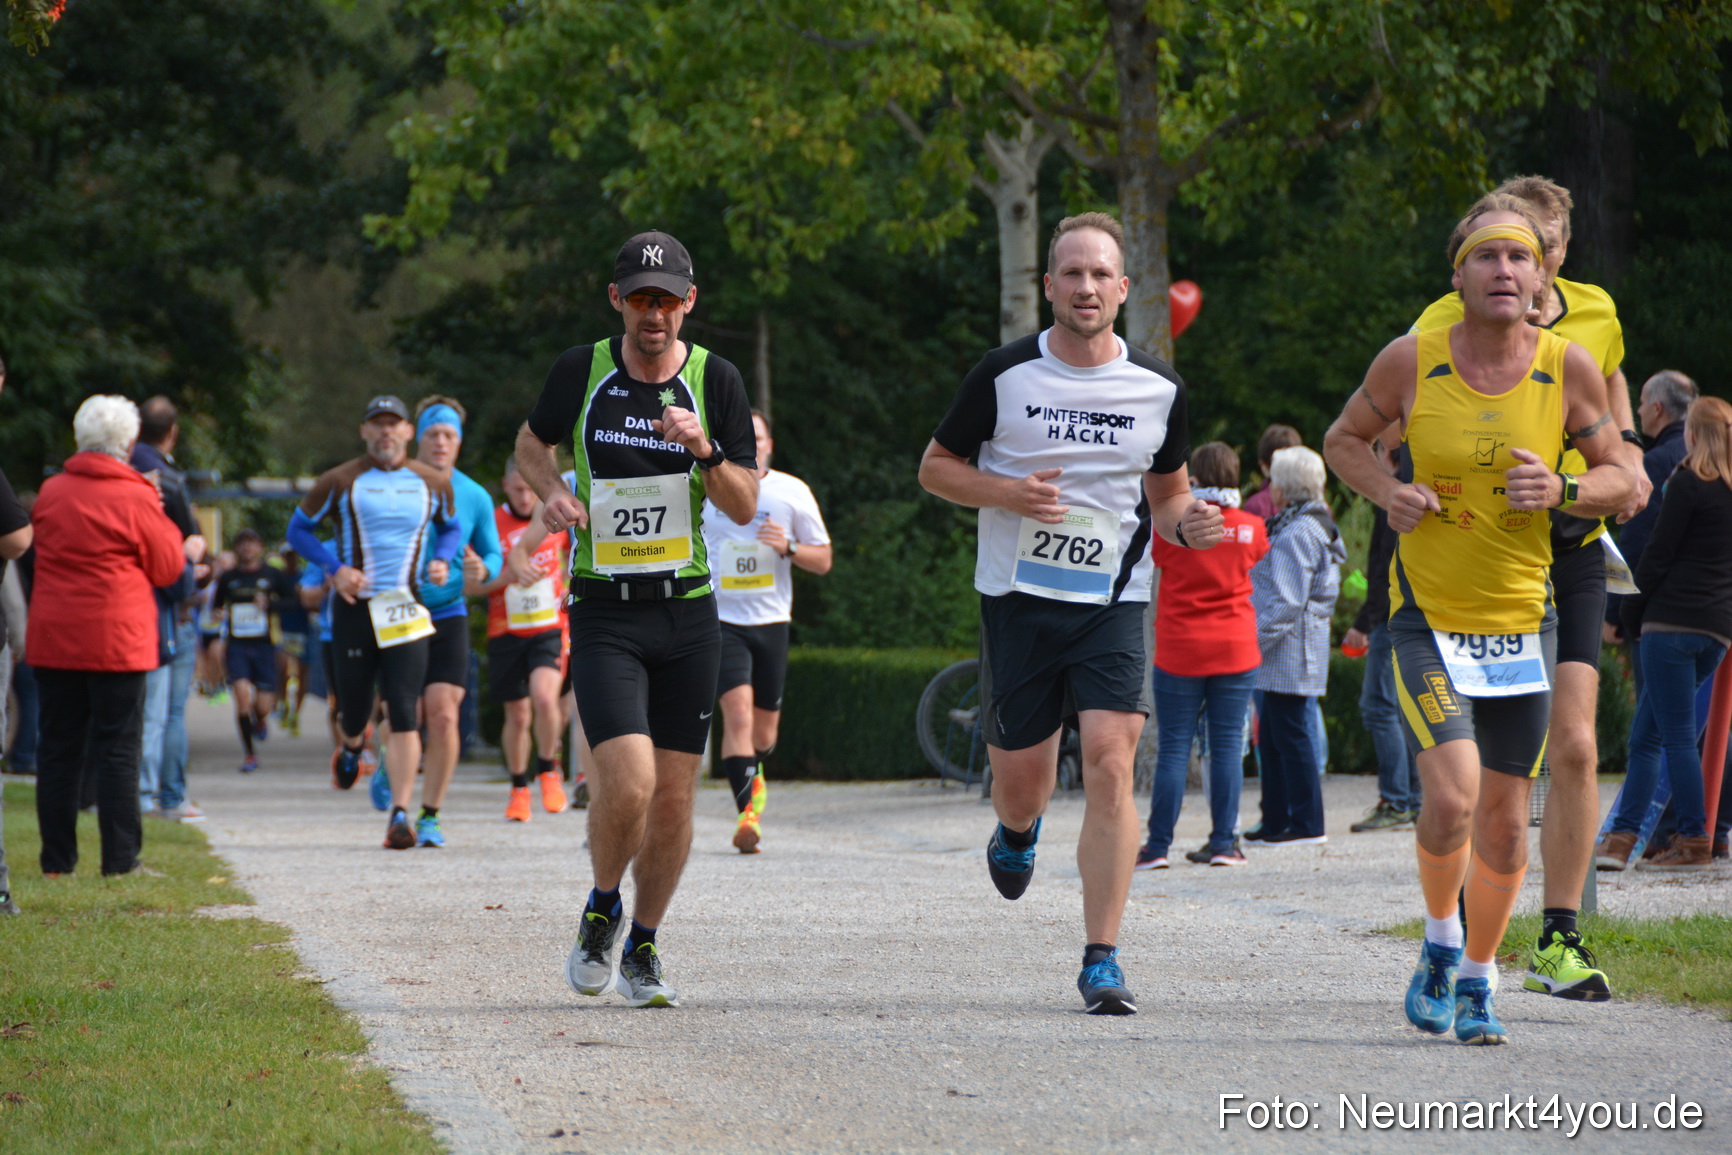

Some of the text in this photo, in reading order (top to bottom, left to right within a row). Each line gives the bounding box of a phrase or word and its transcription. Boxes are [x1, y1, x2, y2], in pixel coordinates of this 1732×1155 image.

[1043, 407, 1136, 430] INTERSPORT
[593, 429, 686, 453] Röthenbach
[1047, 424, 1119, 446] HÄCKL
[625, 486, 661, 496] BOCK
[1433, 480, 1462, 495] Seidl
[613, 505, 667, 537] 257
[1505, 517, 1531, 527] ELIO
[620, 546, 665, 557] Christian
[1031, 530, 1104, 567] 2762
[736, 557, 757, 574] 60
[386, 602, 417, 622] 276
[1448, 631, 1524, 660] 2939
